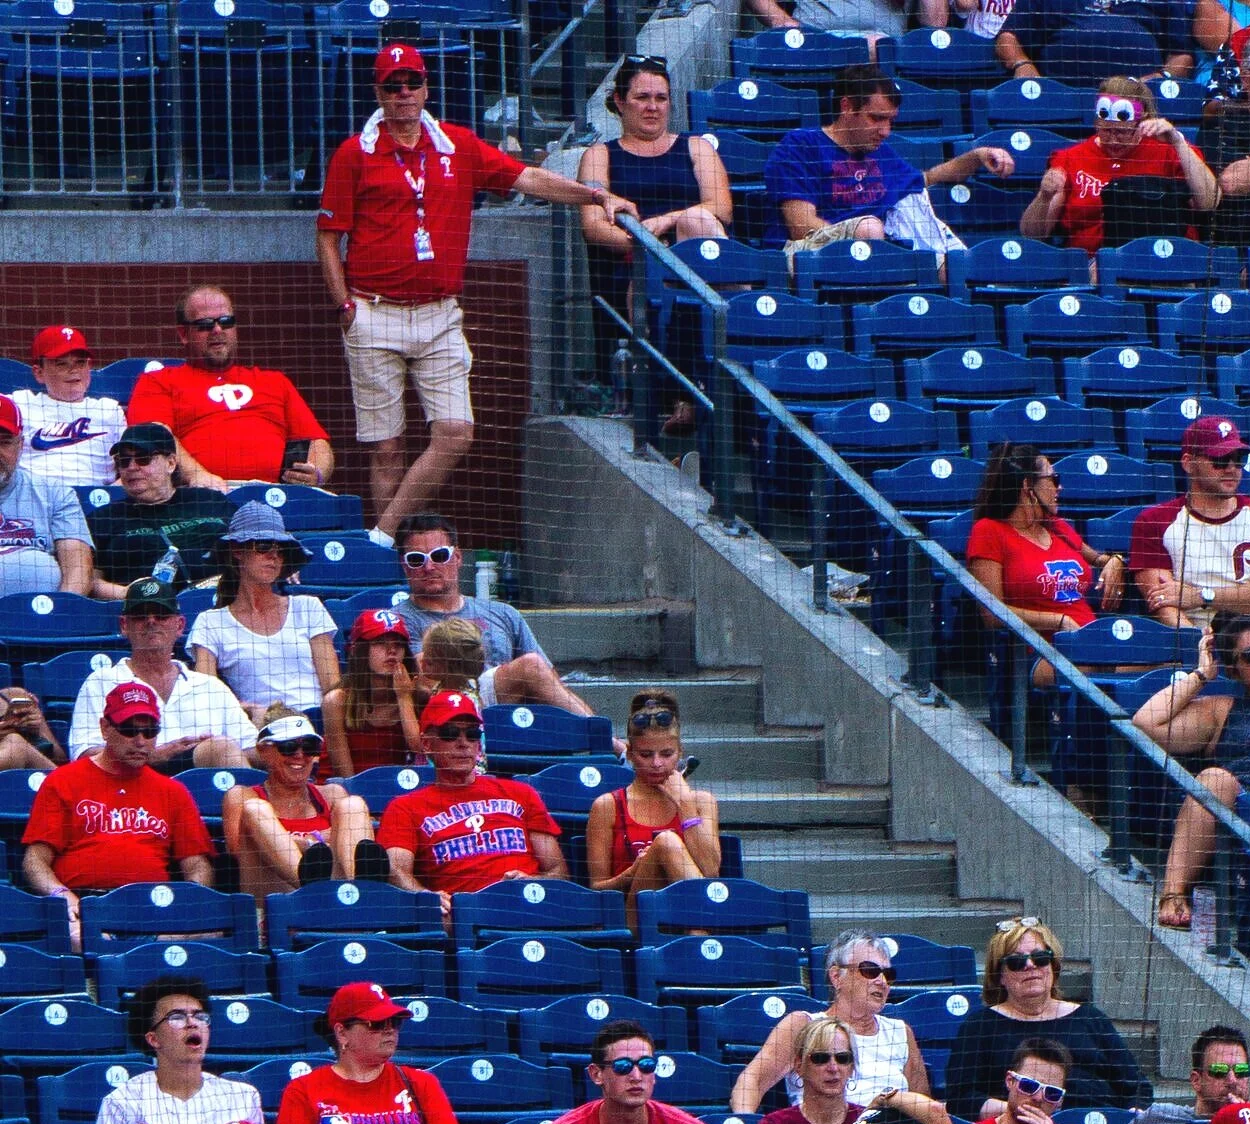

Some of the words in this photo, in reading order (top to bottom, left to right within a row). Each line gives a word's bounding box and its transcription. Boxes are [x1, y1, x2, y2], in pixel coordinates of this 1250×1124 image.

[390, 47, 404, 63] P
[207, 383, 254, 411] P
[42, 417, 92, 438] NIKE
[448, 694, 462, 708] P
[75, 799, 170, 839] Phillies
[464, 814, 484, 833] P
[432, 827, 528, 865] PHILLIES
